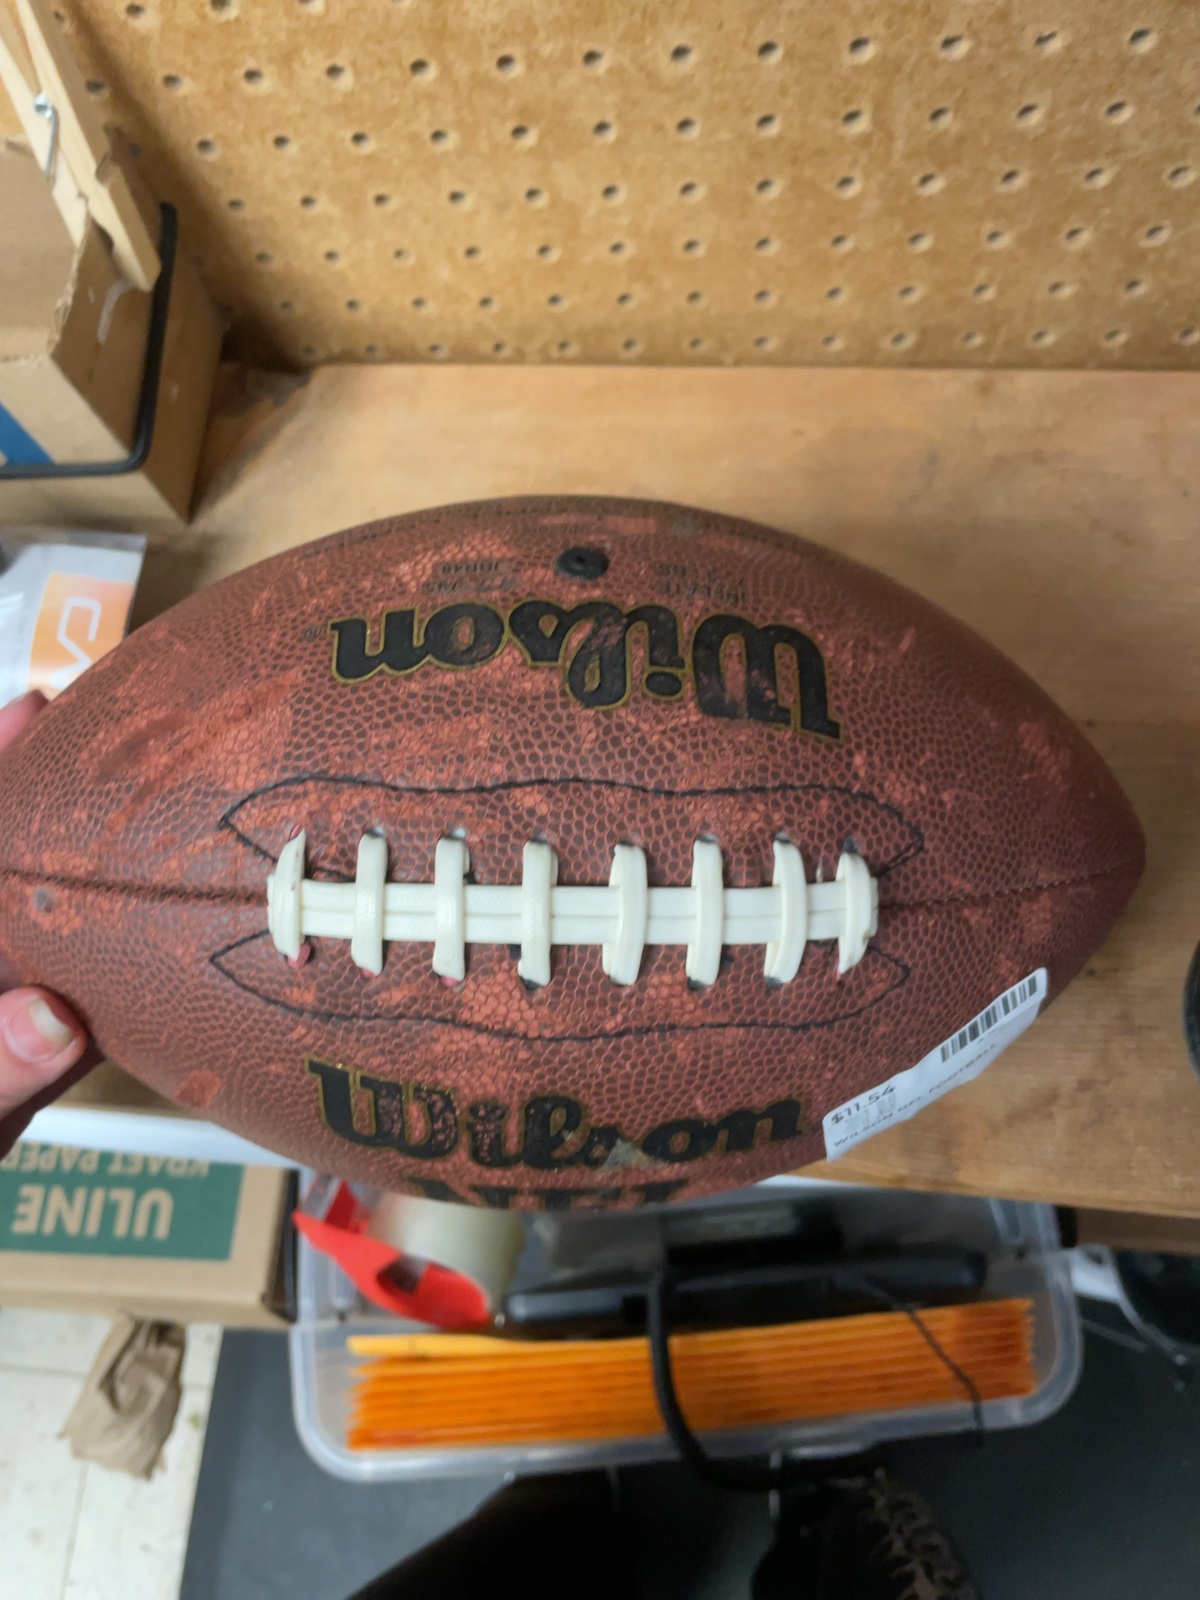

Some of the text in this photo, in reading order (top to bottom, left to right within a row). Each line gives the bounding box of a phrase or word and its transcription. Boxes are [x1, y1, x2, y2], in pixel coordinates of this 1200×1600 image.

[329, 599, 842, 740] Wilson
[304, 1055, 803, 1170] Wilson
[831, 1083, 897, 1125] $11.54
[11, 1183, 175, 1241] ULINE
